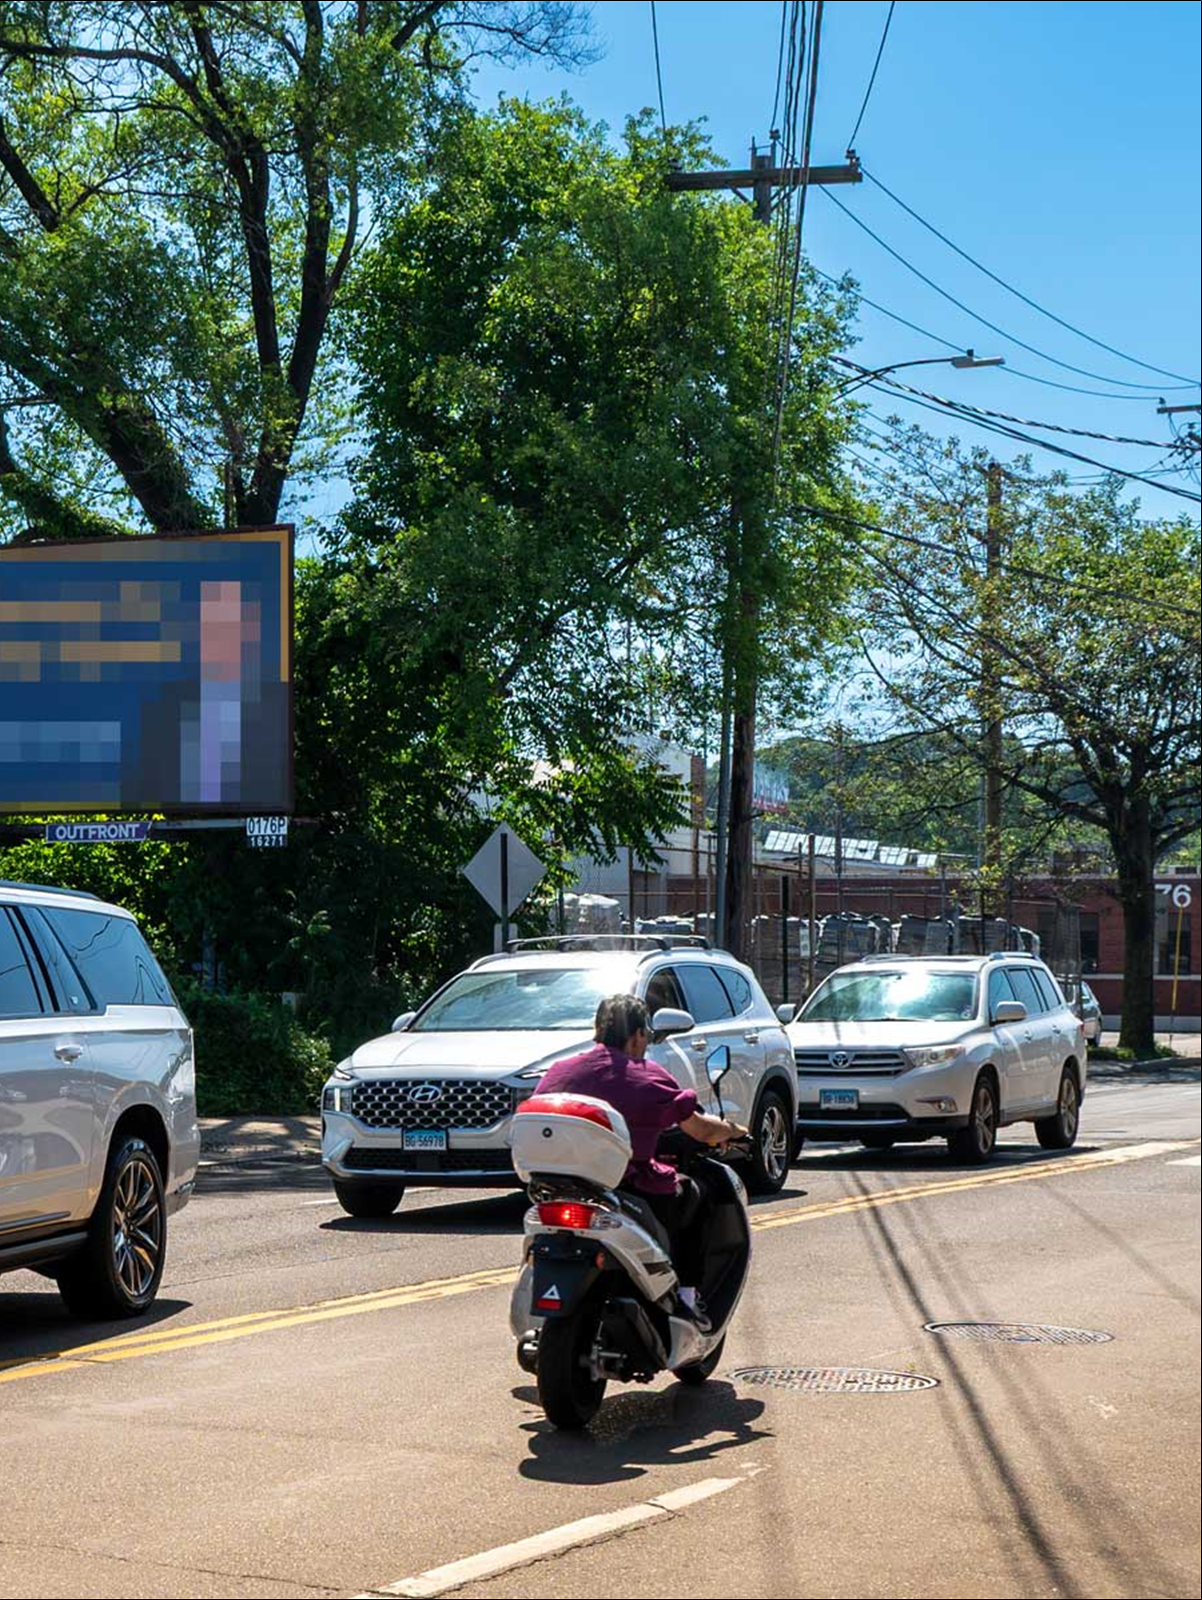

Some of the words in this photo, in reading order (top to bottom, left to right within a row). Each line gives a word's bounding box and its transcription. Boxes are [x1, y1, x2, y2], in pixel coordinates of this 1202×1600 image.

[55, 823, 140, 840] OUTFRONT
[248, 817, 285, 834] 0176P
[251, 835, 284, 847] 16271
